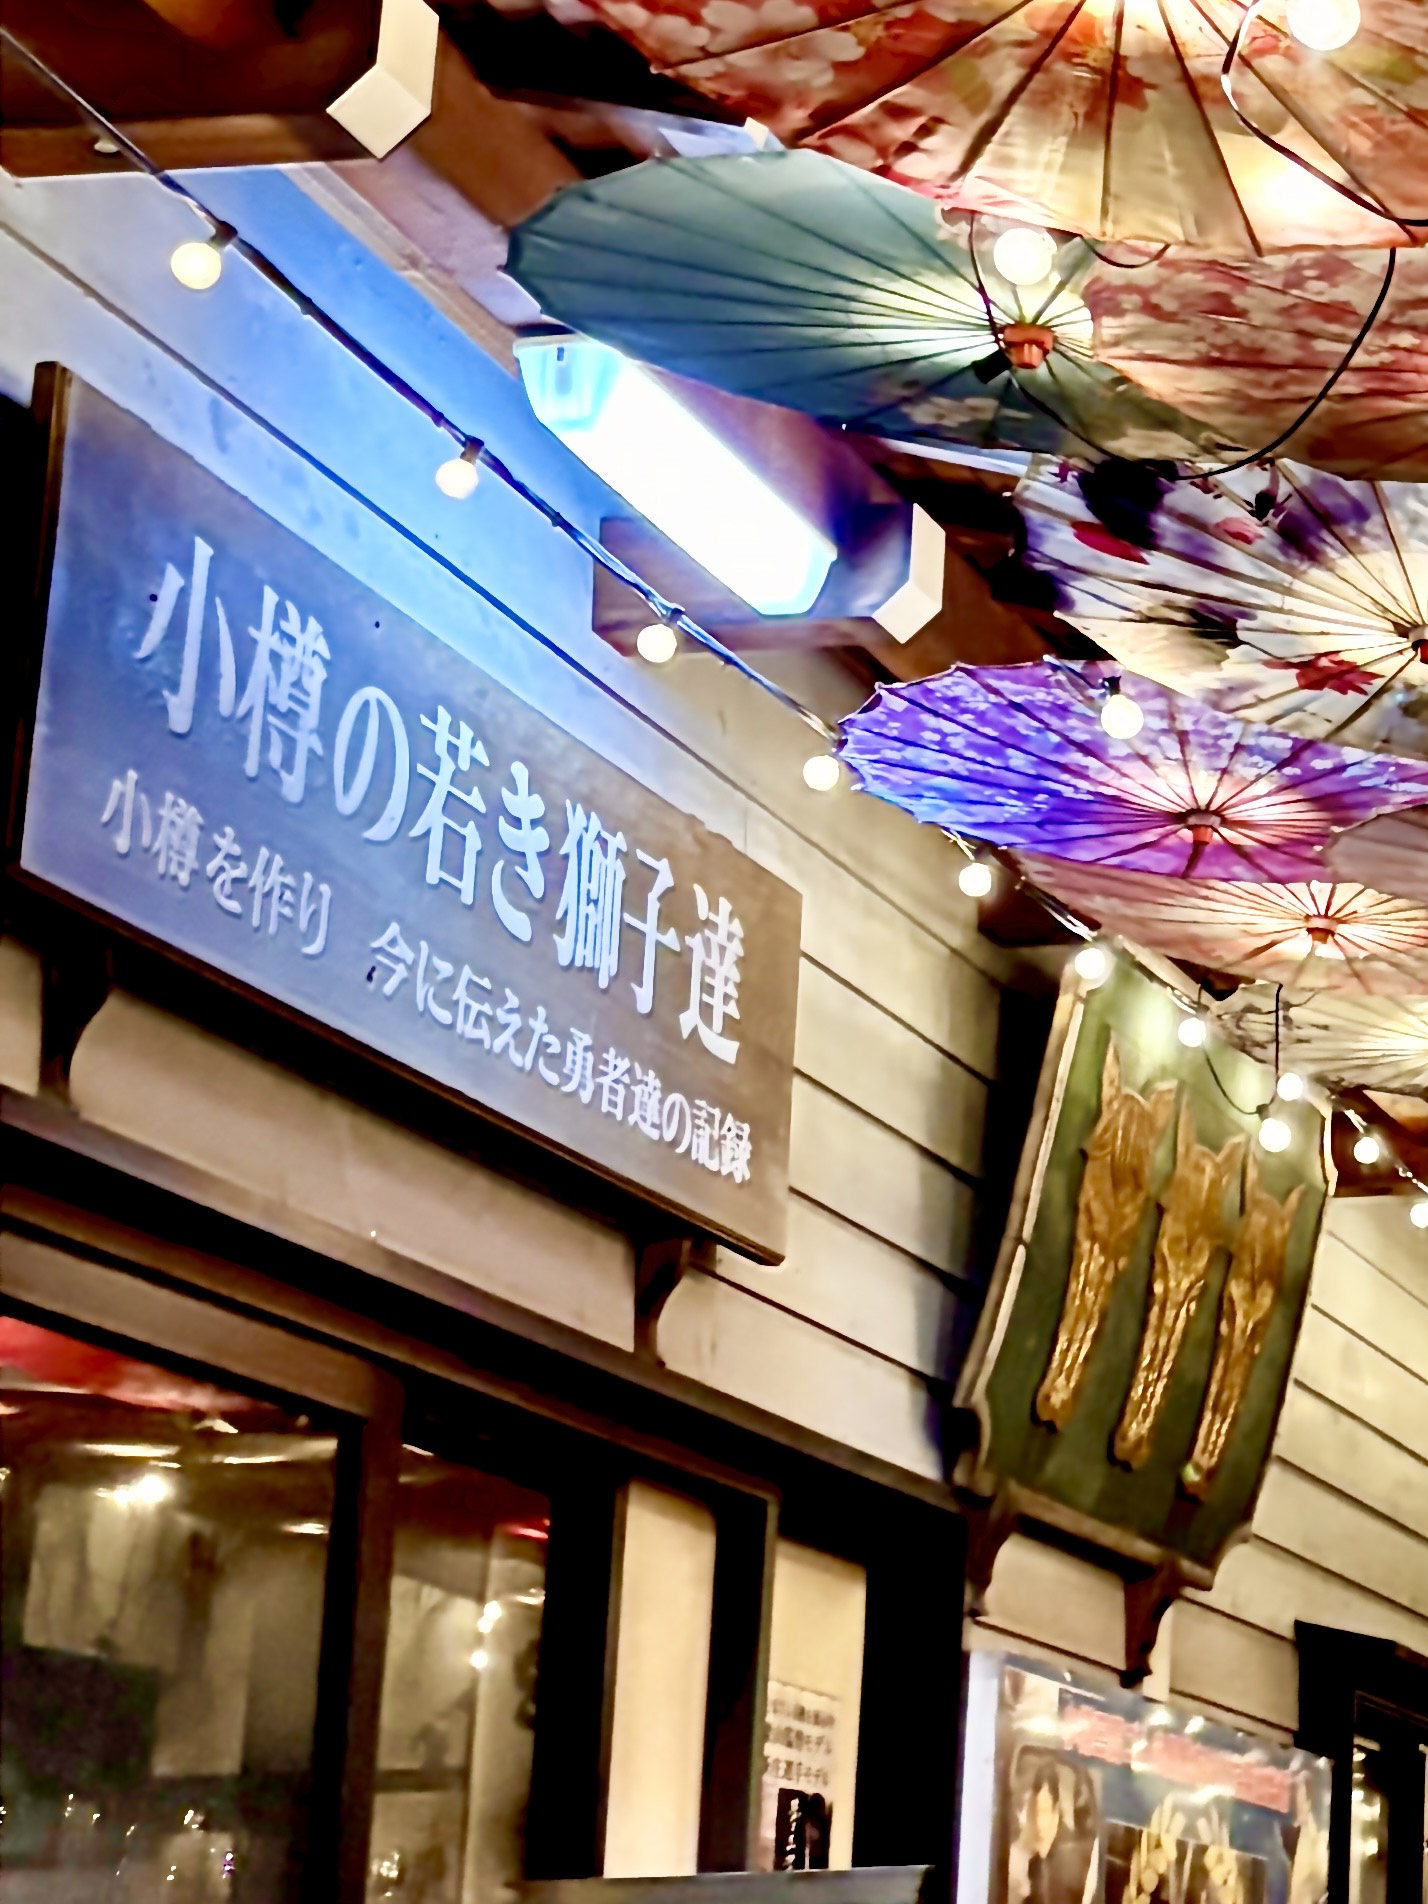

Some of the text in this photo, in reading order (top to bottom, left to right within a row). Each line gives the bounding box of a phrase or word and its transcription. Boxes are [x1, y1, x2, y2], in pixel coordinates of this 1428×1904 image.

[101, 768, 752, 1183] 小樽を作り 今に伝えた勇者達の記録
[133, 536, 744, 1064] 小樽の若き獅子達
